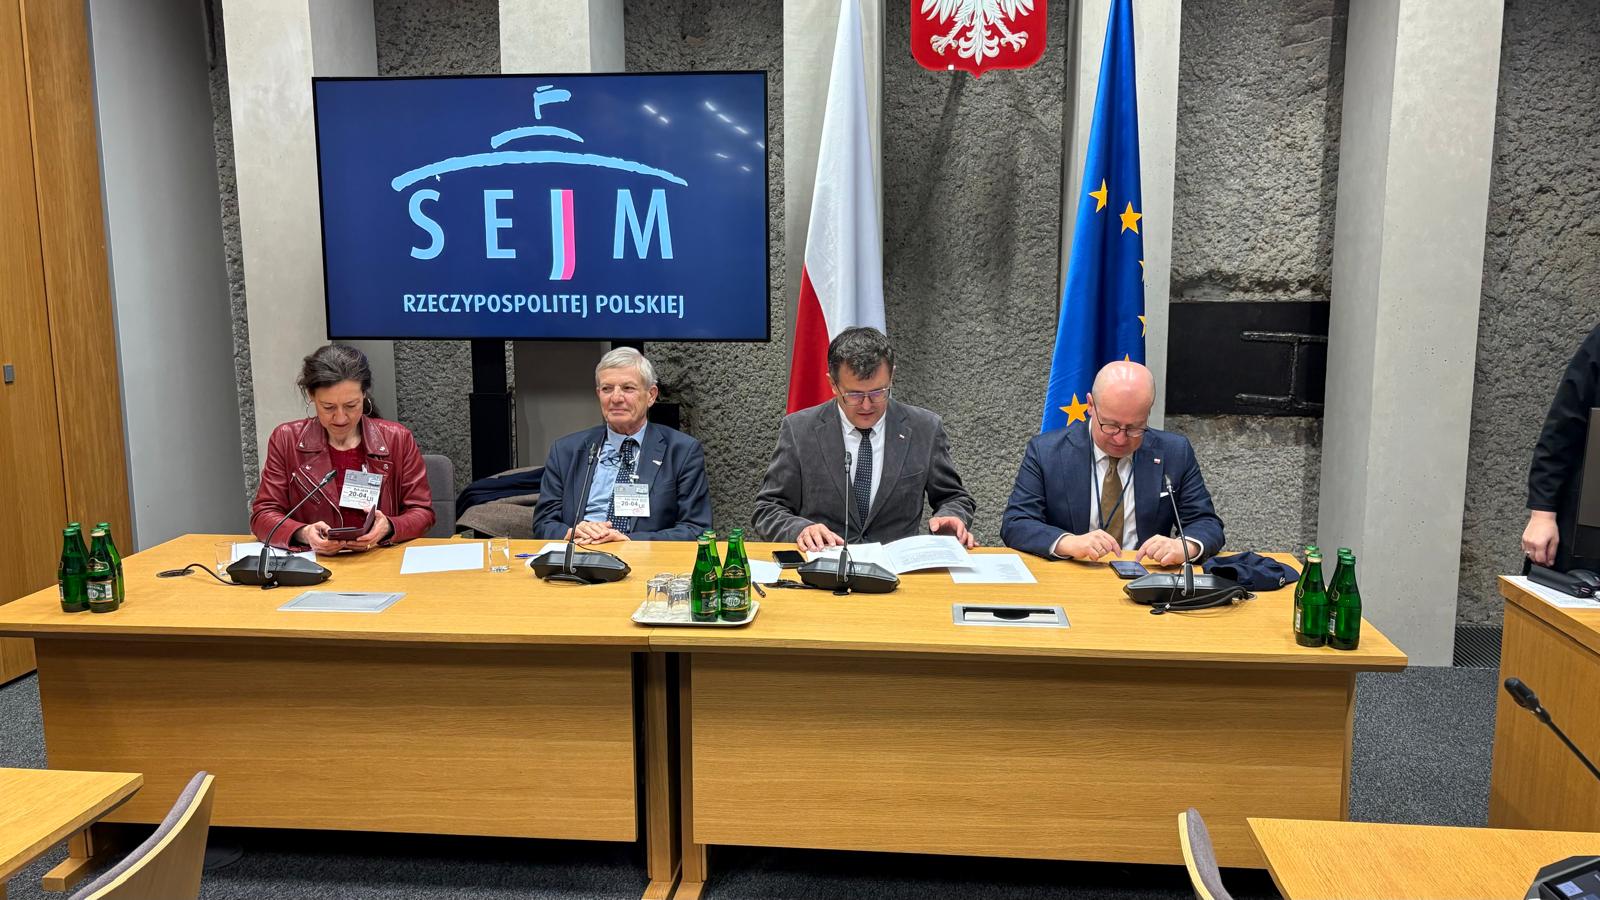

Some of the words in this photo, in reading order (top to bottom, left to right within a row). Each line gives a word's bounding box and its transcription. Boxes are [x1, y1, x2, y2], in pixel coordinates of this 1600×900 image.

[408, 188, 675, 281] SEJM
[403, 293, 588, 319] RZECZYPOSPOLITEJ
[595, 293, 685, 320] POLSKIEJ
